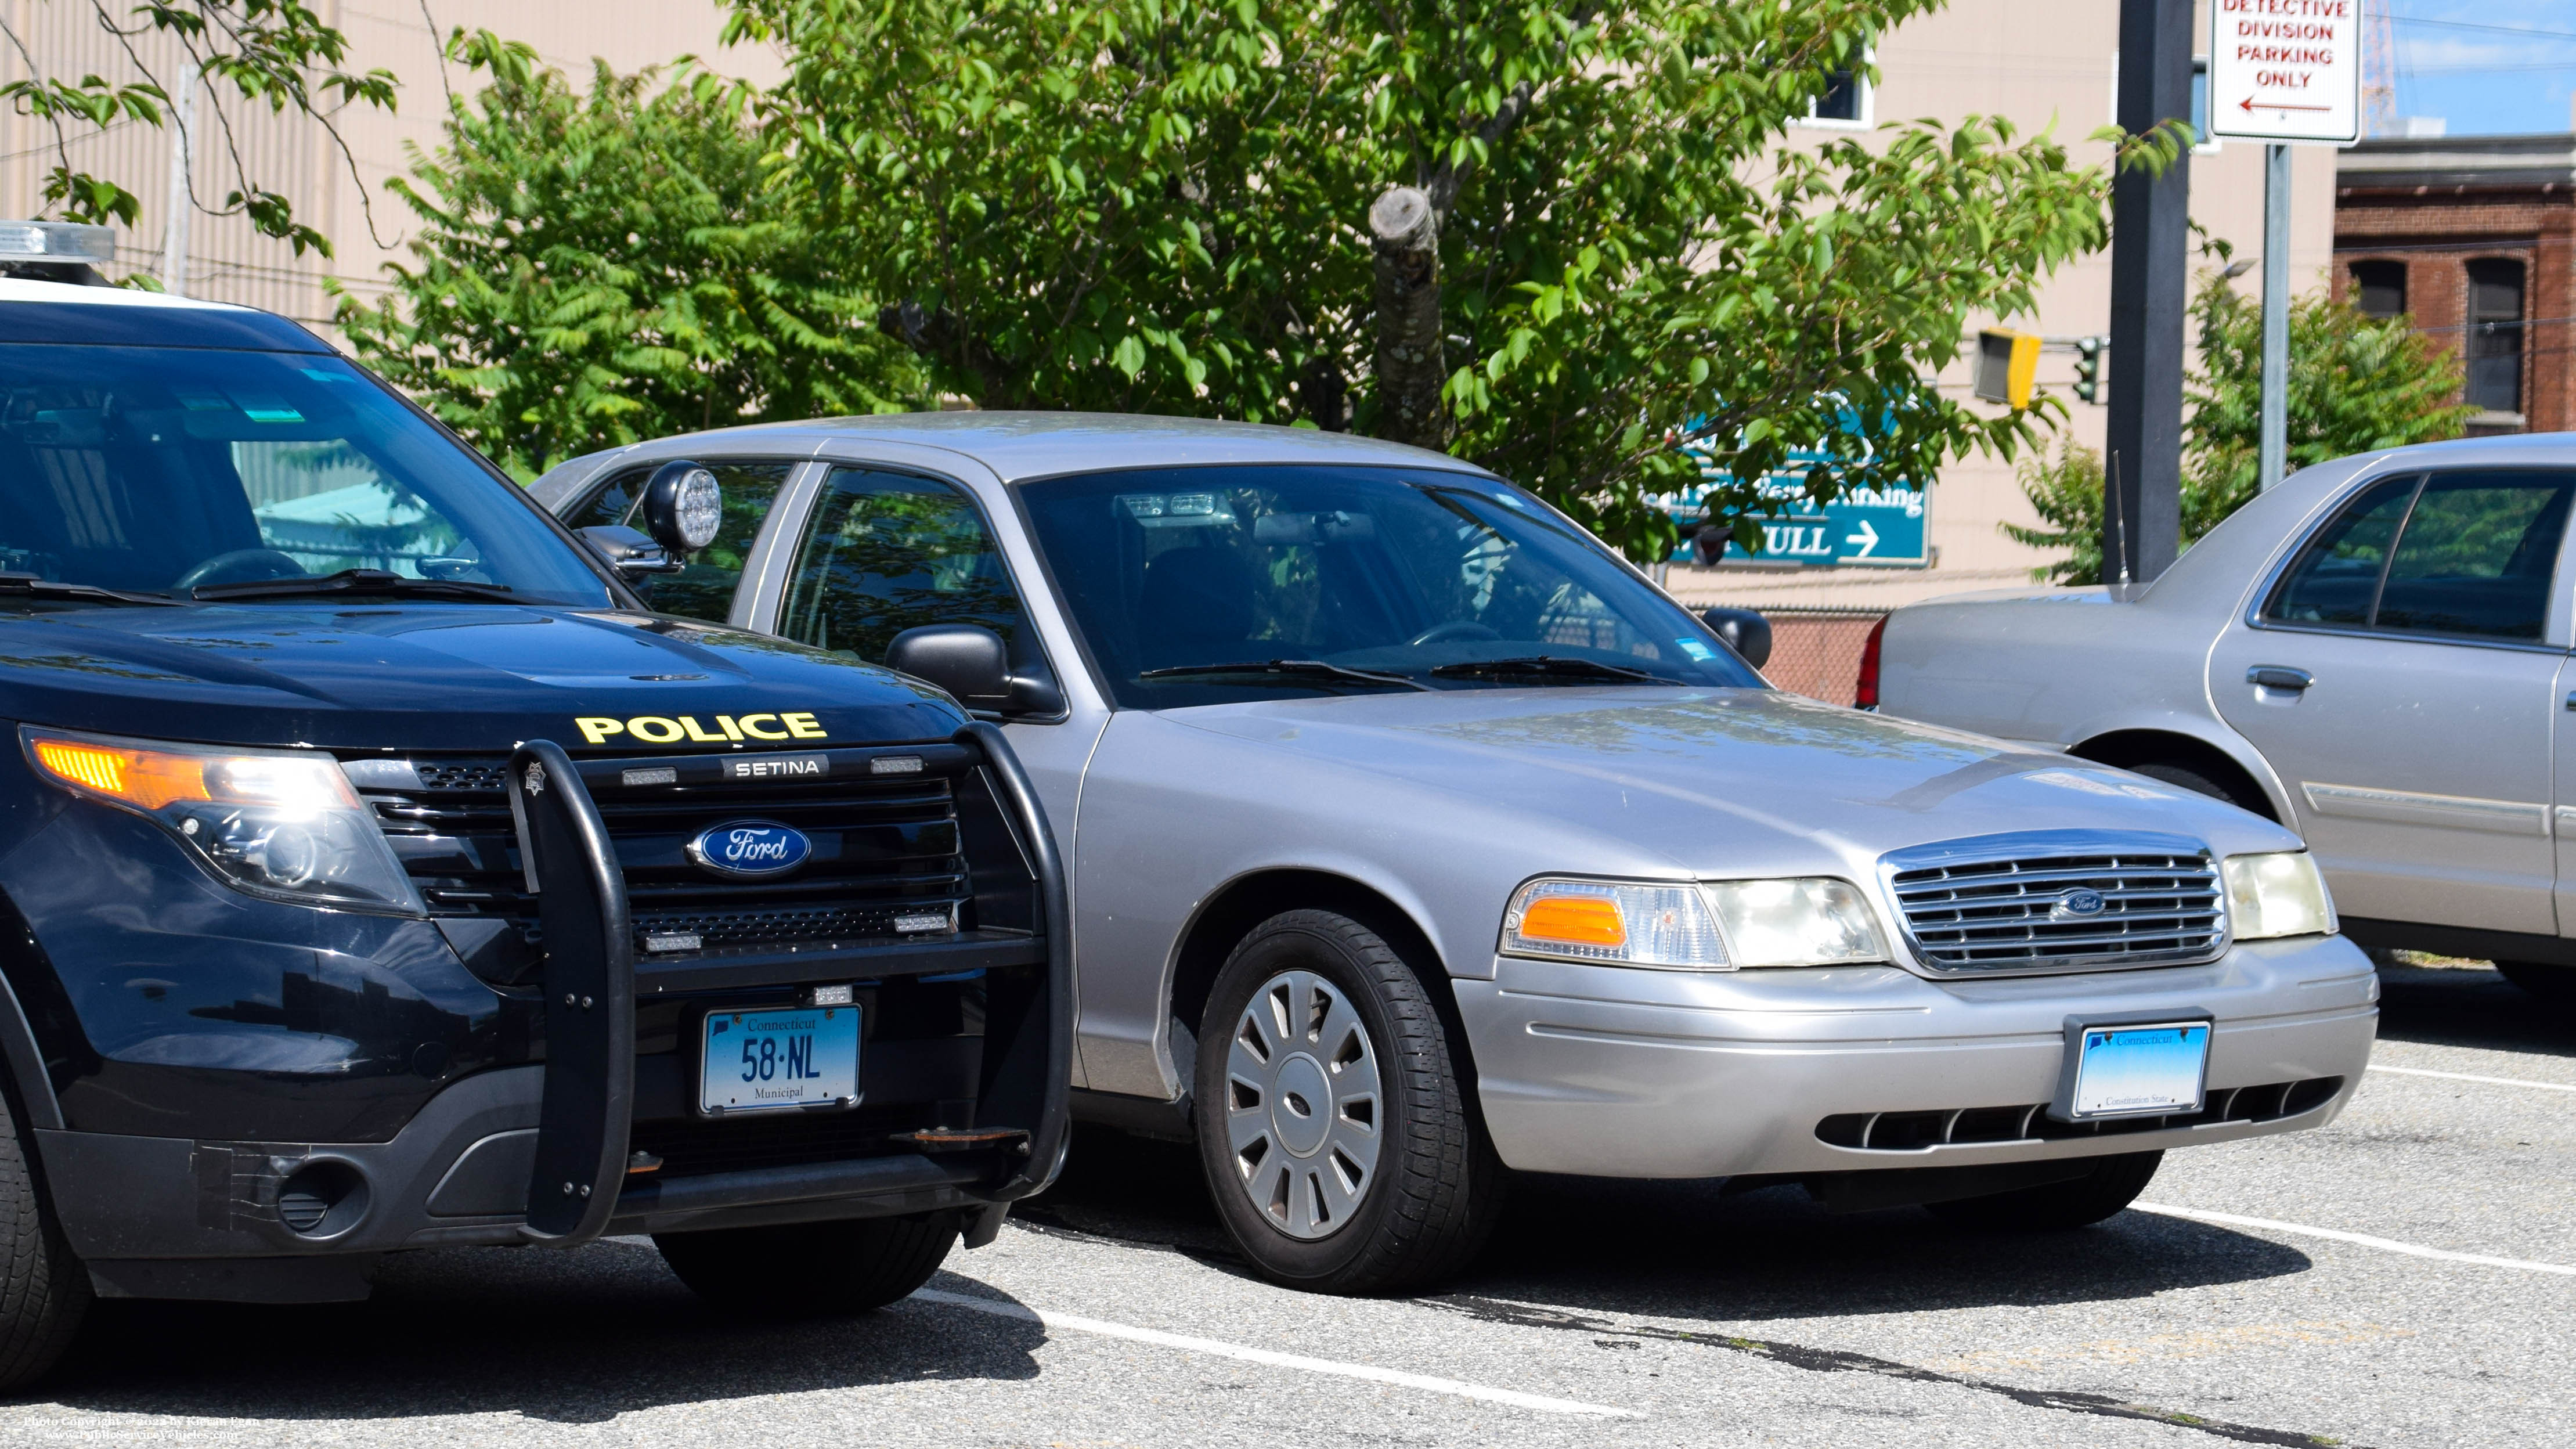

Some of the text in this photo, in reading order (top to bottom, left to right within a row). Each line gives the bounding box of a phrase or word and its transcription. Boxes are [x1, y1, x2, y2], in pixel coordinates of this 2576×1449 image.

[2224, 0, 2350, 17] DETECTIVE
[2239, 20, 2333, 40] DIVISION
[2238, 44, 2333, 64] PARKING
[2257, 69, 2312, 88] ONLY
[1762, 526, 1831, 556] ULL
[575, 712, 827, 744] POLICE
[735, 760, 820, 777] SETINA
[726, 828, 787, 860] Ford
[2074, 896, 2098, 910] Ford
[748, 1018, 816, 1032] Connecticut
[2117, 1033, 2173, 1046] Connecticut
[755, 1085, 803, 1099] Municipal
[2106, 1094, 2169, 1106] Constitution State
